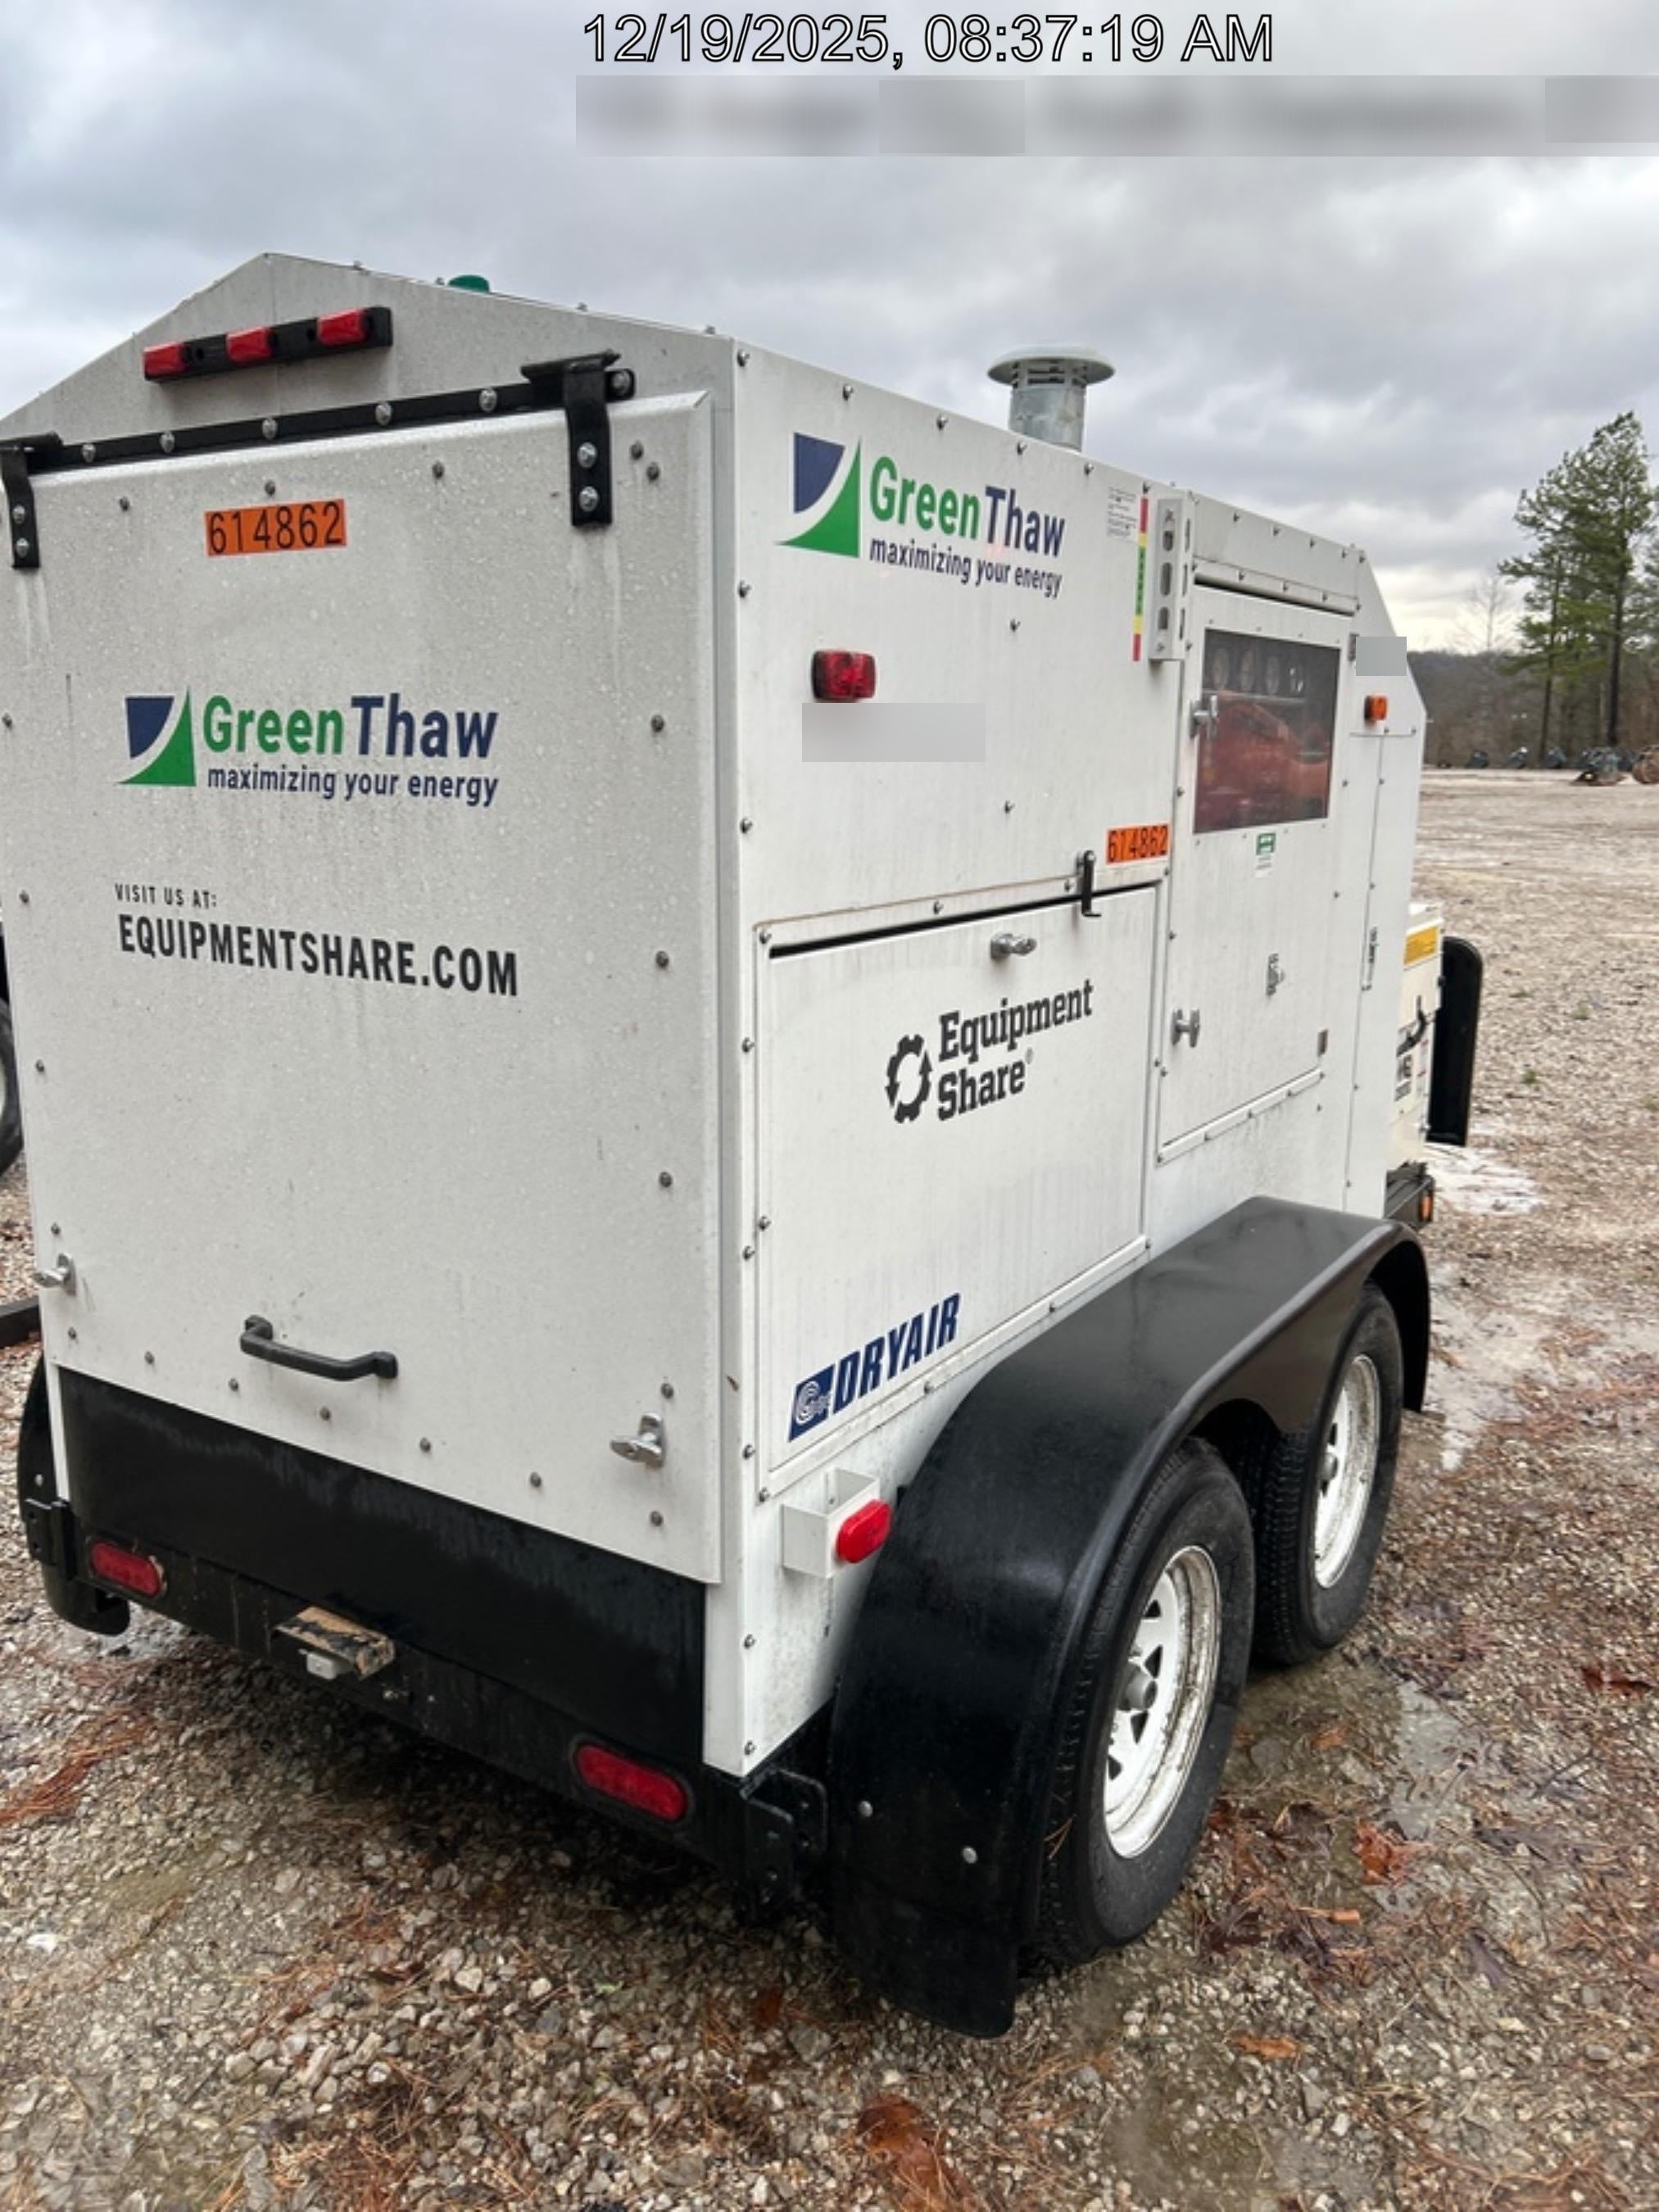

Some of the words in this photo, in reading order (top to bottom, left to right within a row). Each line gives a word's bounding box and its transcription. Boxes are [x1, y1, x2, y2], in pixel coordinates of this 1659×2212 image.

[207, 500, 344, 555] 614862
[869, 535, 971, 583] maximizing
[976, 557, 1011, 587] your
[1014, 566, 1063, 598] energy
[207, 763, 336, 800] maximizing
[344, 772, 399, 802] your
[408, 774, 499, 807] energy
[1108, 826, 1168, 863] 614862
[114, 884, 156, 905] VISIT
[165, 887, 185, 907] US
[193, 890, 217, 909] AT:
[119, 914, 518, 997] EQUIPMENTSHARE.COM
[939, 978, 1094, 1064] Equipment
[833, 1292, 960, 1414] DRYAIR
